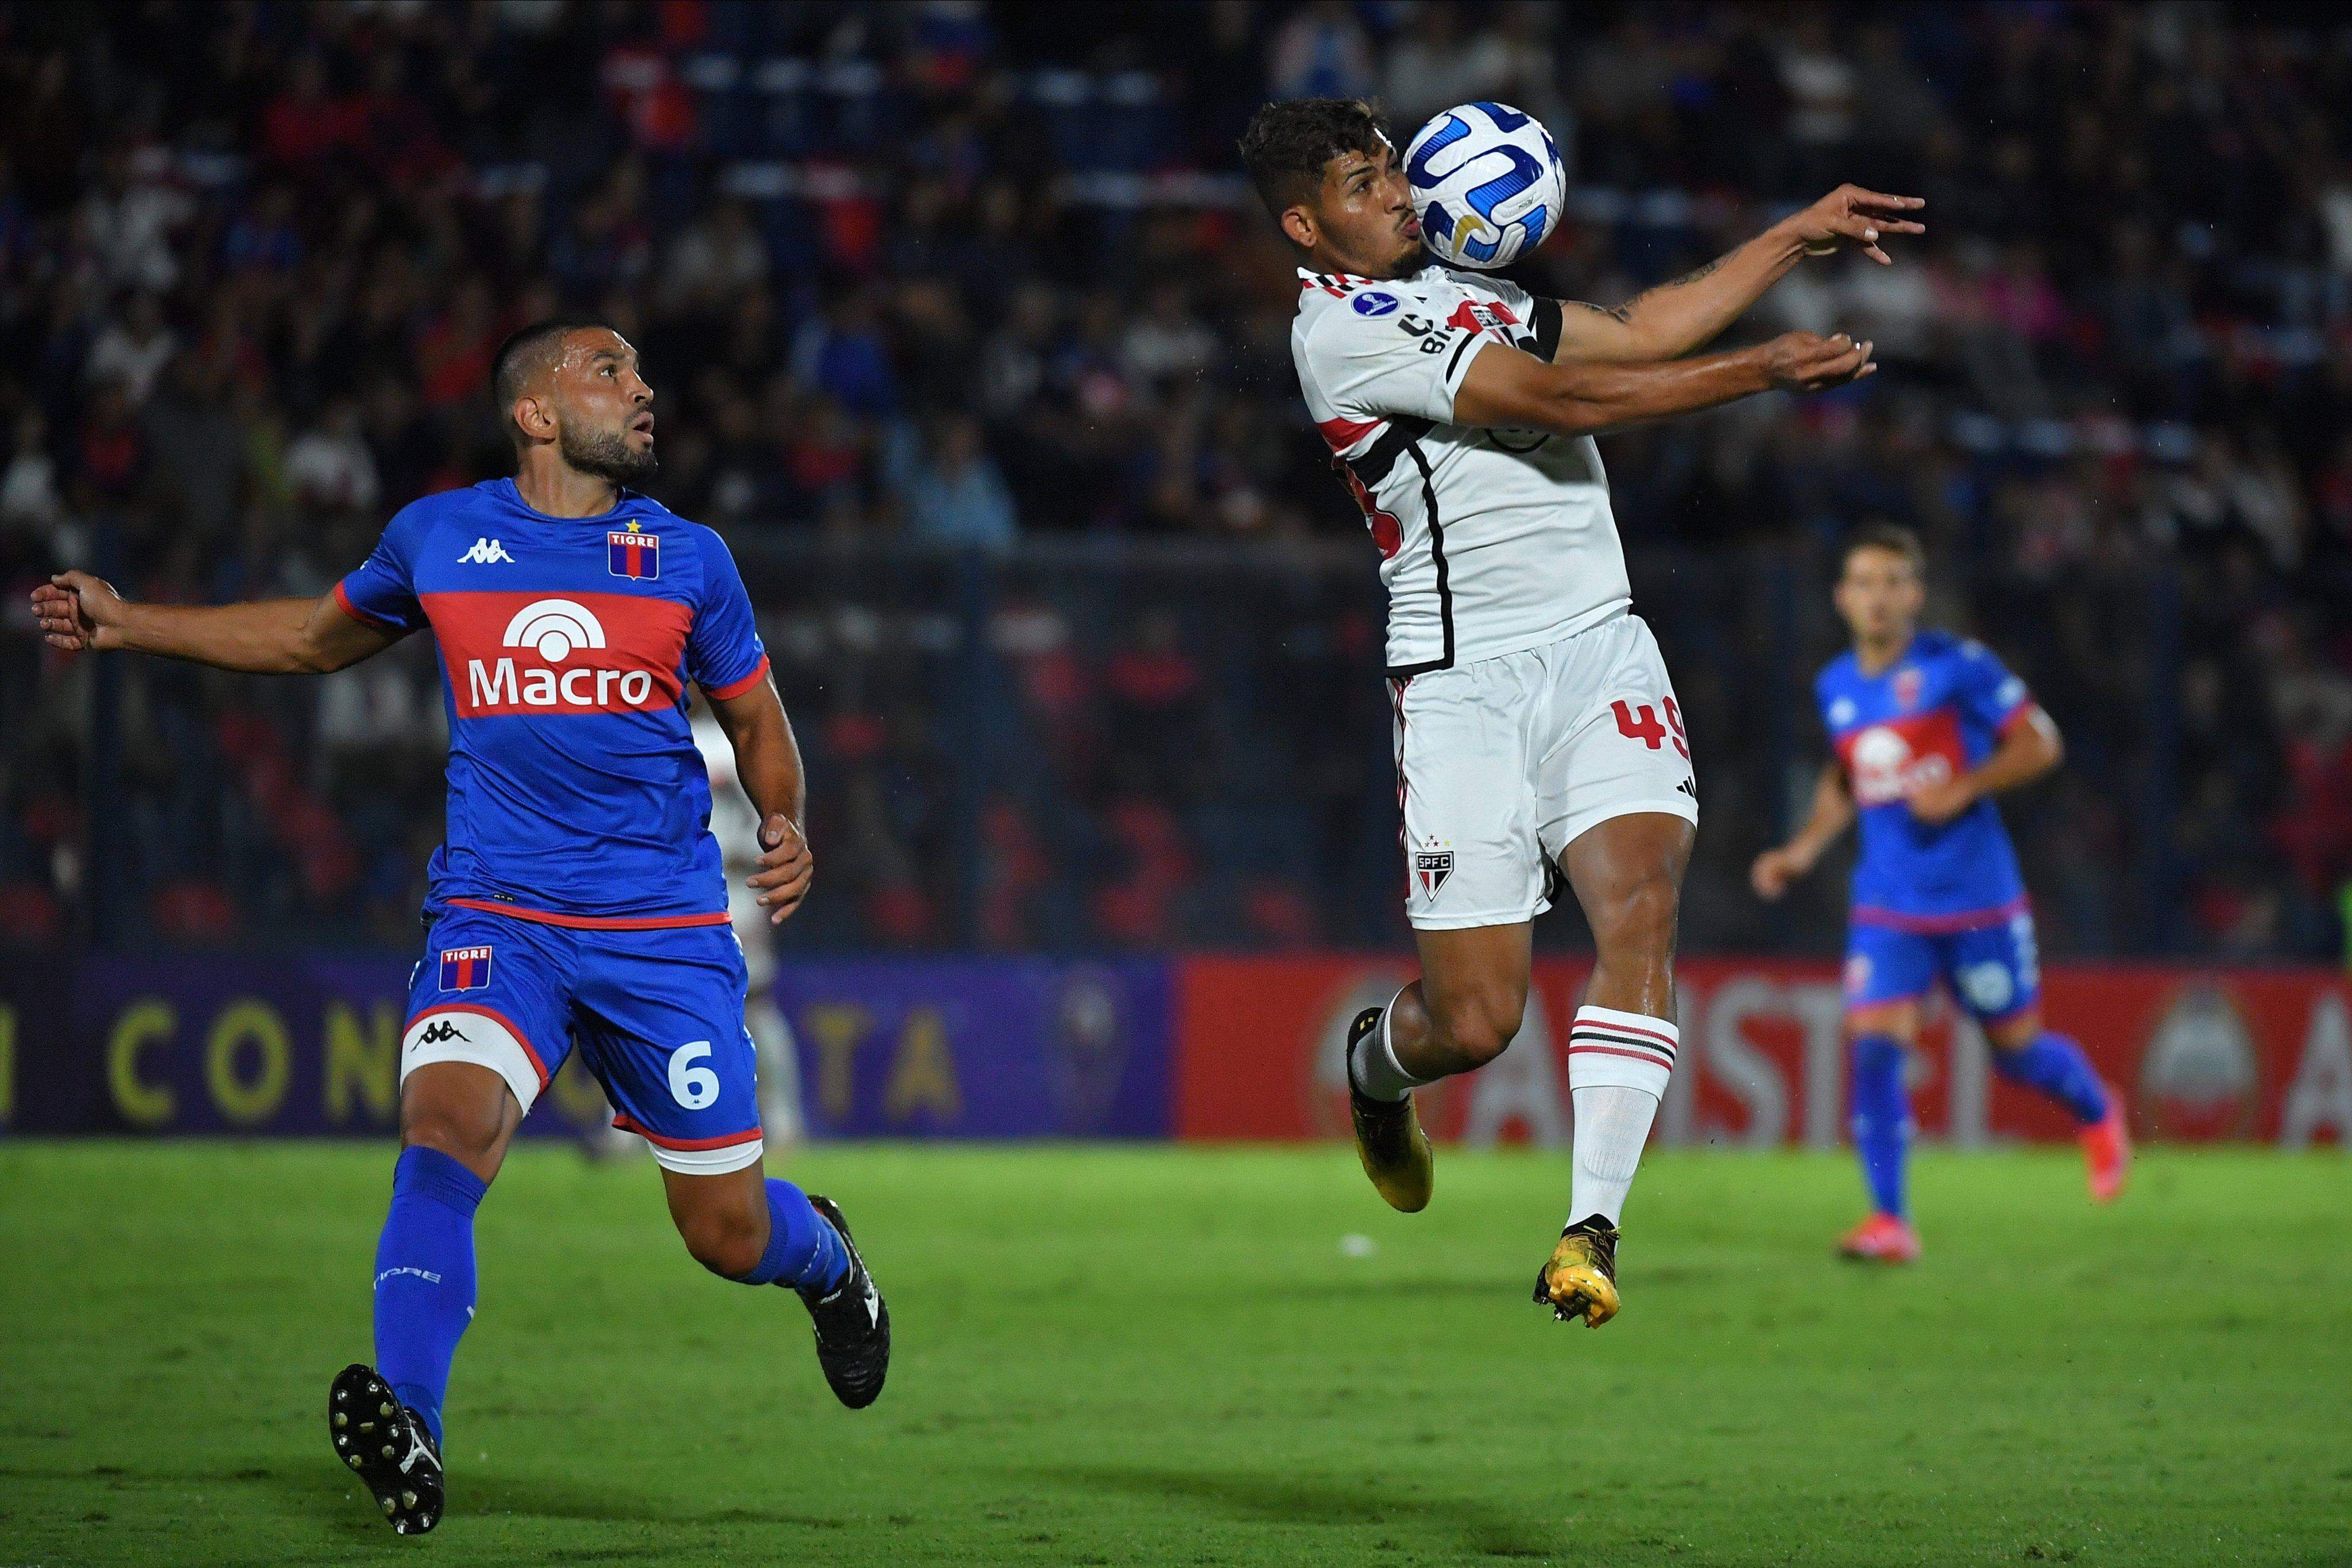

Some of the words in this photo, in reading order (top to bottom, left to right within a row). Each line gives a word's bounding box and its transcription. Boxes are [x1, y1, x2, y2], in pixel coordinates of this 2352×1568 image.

[612, 533, 655, 548] TIGRE
[467, 657, 652, 708] Macro
[1610, 695, 1691, 765] 49
[1418, 856, 1450, 869] SPFC
[445, 948, 488, 962] TIGRE
[667, 1040, 720, 1110] 6
